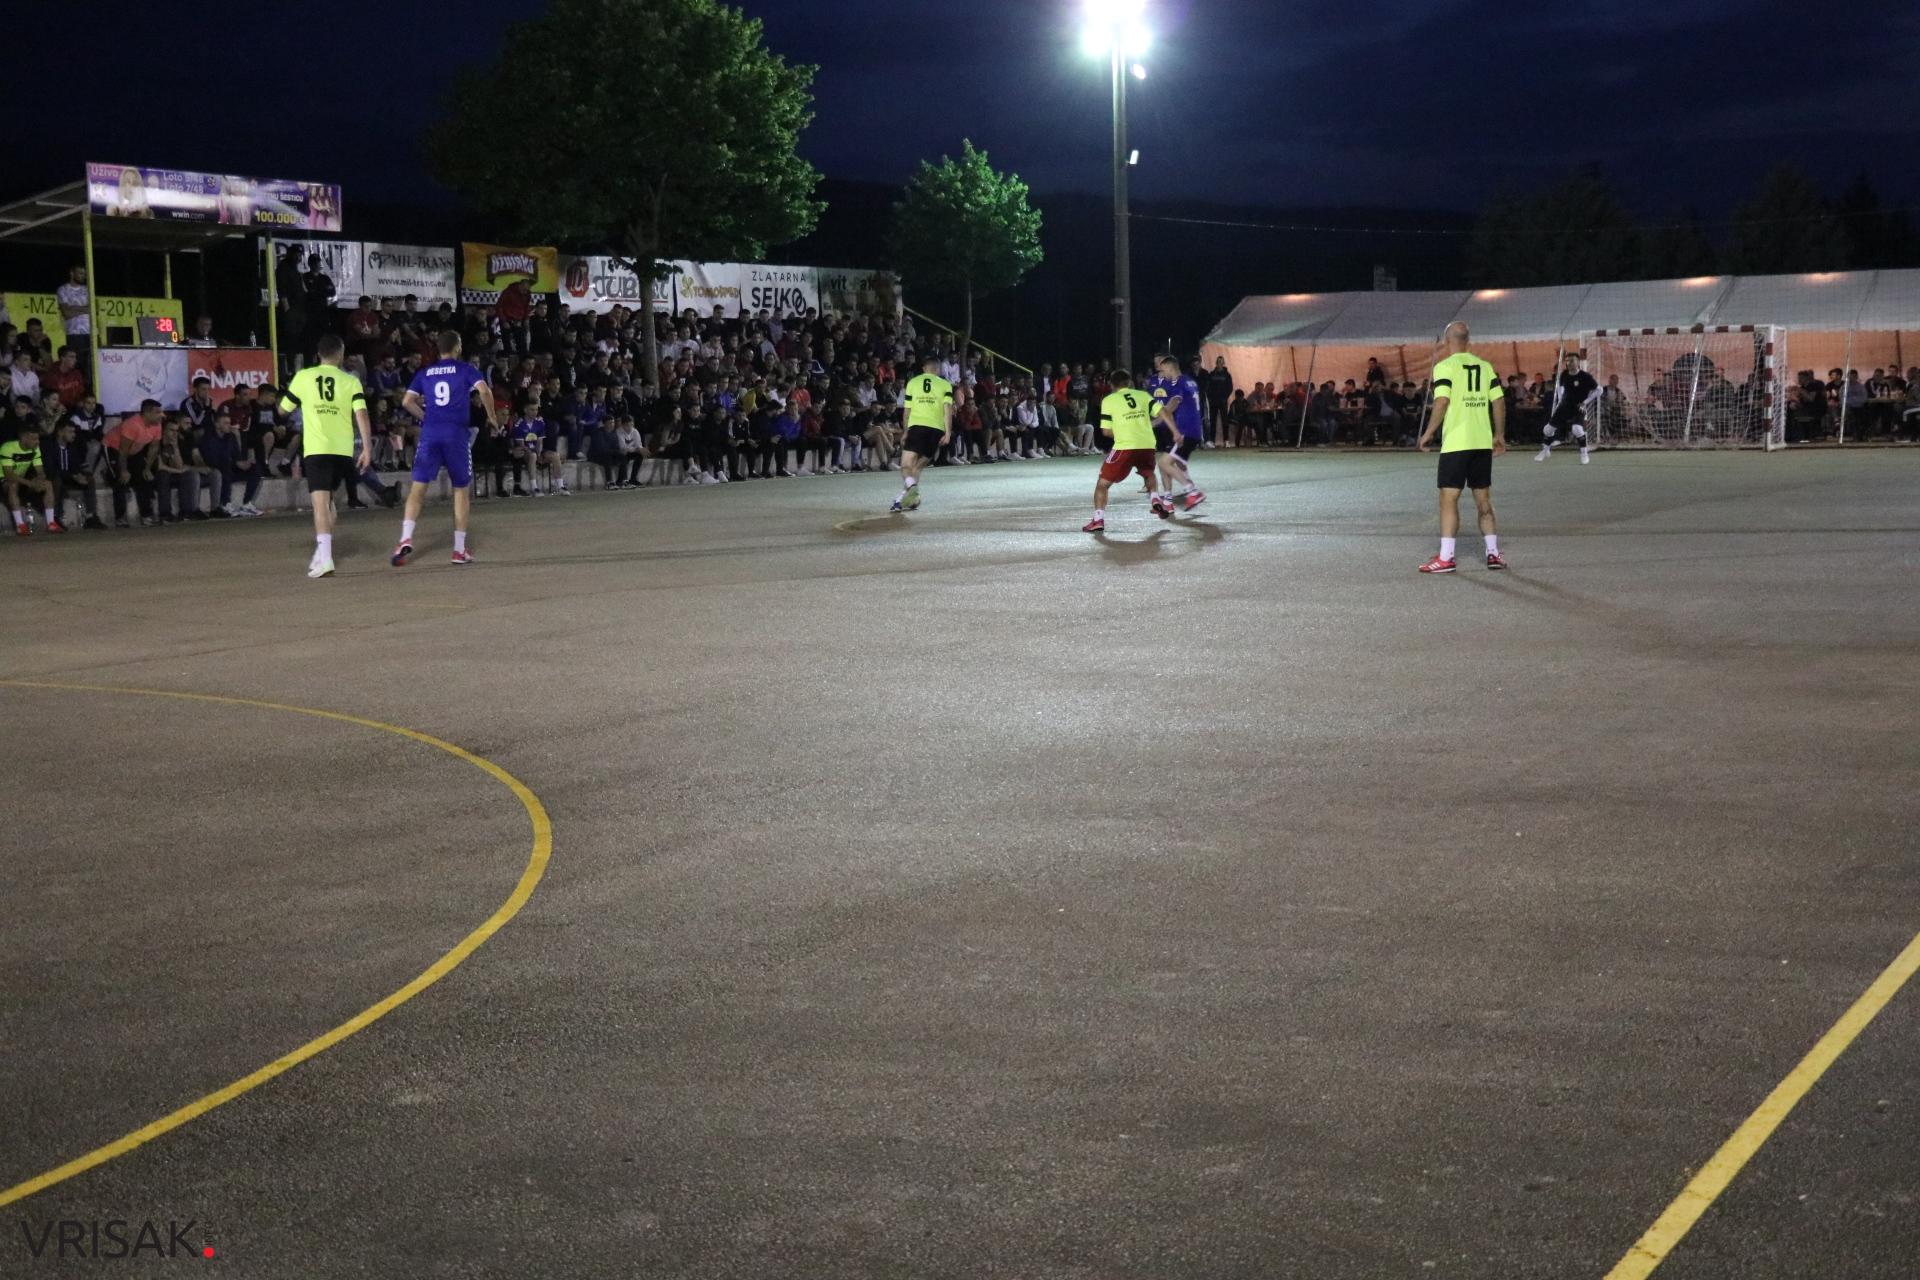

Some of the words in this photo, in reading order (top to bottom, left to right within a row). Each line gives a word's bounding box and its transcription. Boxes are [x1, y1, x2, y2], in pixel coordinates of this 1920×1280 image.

[752, 270, 807, 282] ZLATARNA
[316, 375, 336, 402] 13
[923, 378, 932, 393] 6
[1463, 364, 1481, 392] 11
[434, 381, 451, 407] 9
[1123, 393, 1137, 409] 5
